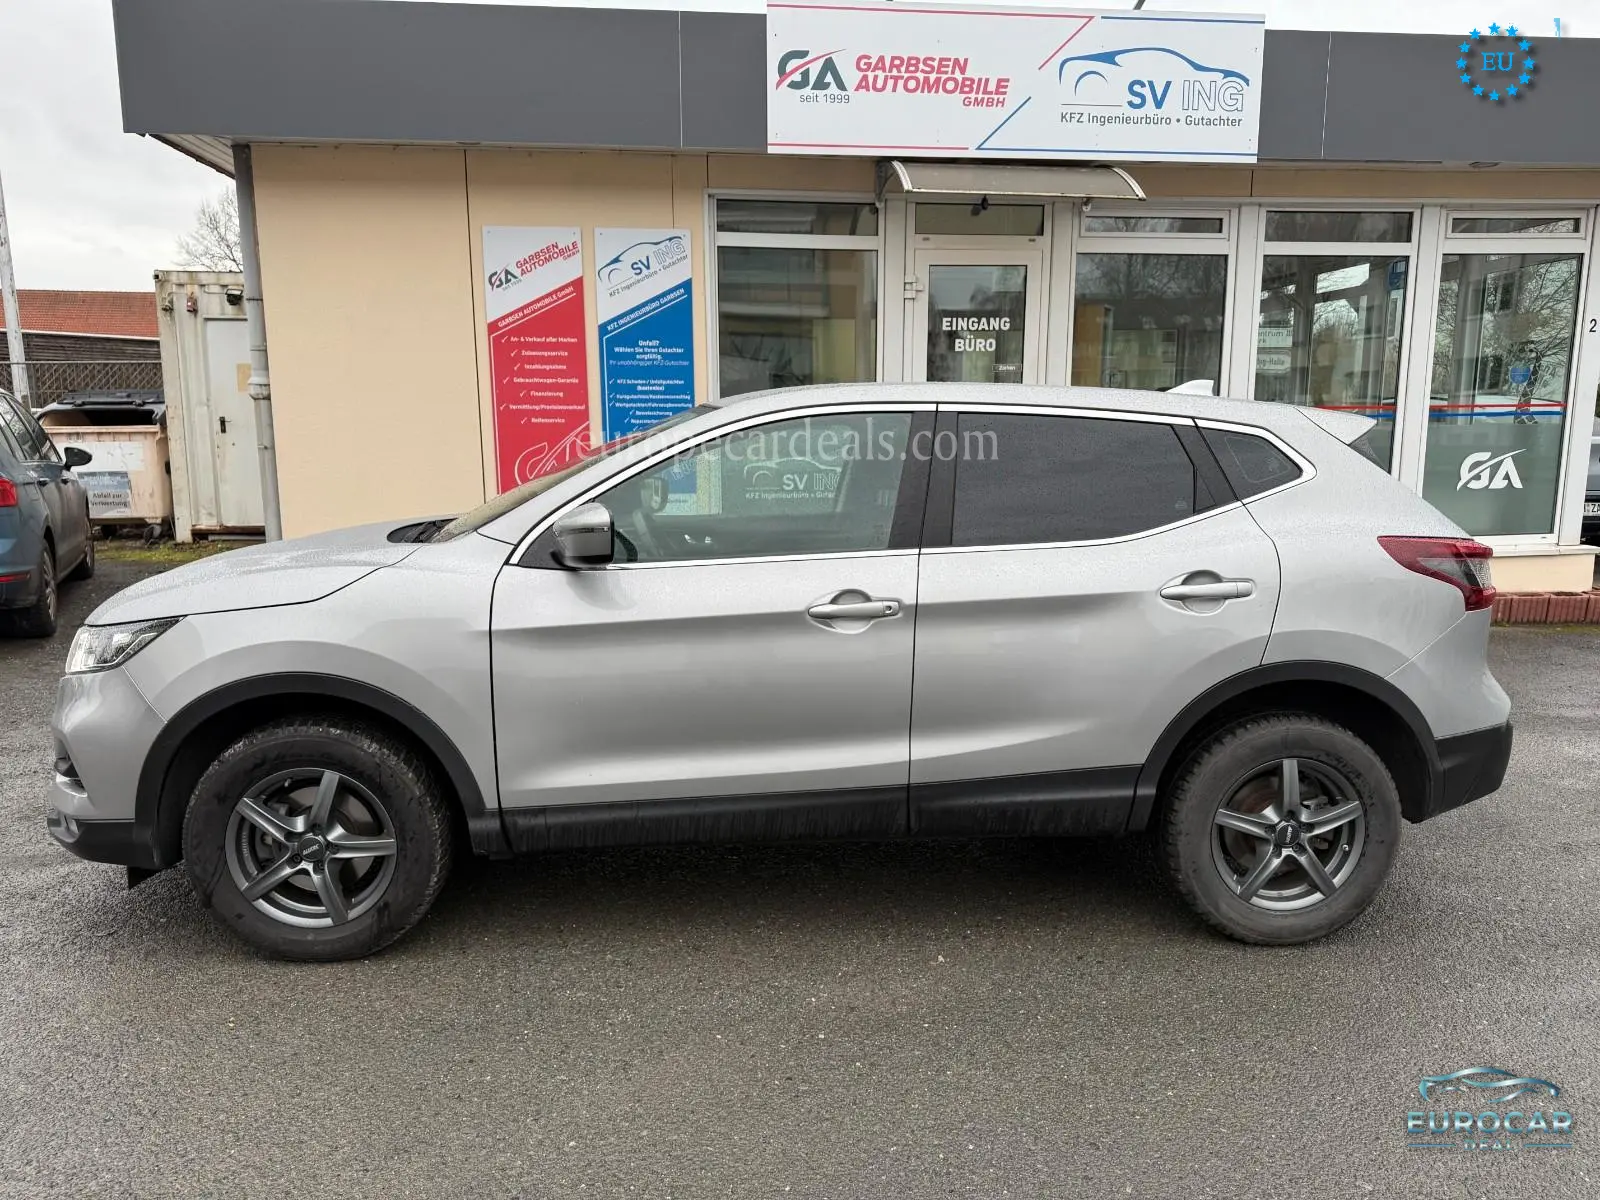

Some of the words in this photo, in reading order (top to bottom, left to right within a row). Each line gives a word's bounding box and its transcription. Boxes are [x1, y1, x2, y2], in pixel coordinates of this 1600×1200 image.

[776, 49, 847, 91] GA
[855, 54, 969, 75] GARBSEN
[854, 74, 1010, 96] AUTOMOBILE
[1126, 79, 1172, 110] SV
[1181, 79, 1244, 112] ING
[799, 92, 820, 103] seit
[823, 94, 850, 104] 1999
[962, 96, 1006, 107] GMBH
[1060, 112, 1084, 123] KFZ
[1087, 113, 1172, 126] Ingenieurbüro
[1185, 115, 1243, 127] Gutachter
[515, 242, 559, 269] GARBSEN
[520, 241, 579, 277] AUTOMOBILE
[630, 255, 651, 276] SV
[653, 239, 686, 266] ING
[608, 287, 620, 298] KFZ
[620, 270, 658, 293] Ingenieurbüro
[662, 254, 688, 271] Gutachter
[497, 312, 524, 327] GARBSEN
[523, 295, 557, 315] AUTOMOBILE
[606, 321, 619, 331] KFZ
[618, 301, 660, 325] INGENIEURBÜRO
[659, 288, 685, 304] GARBSEN
[942, 317, 1011, 331] EINGANG
[1589, 318, 1598, 332] 2
[954, 335, 997, 352] BÜRO
[782, 473, 808, 491] SV
[1457, 449, 1527, 492] GA
